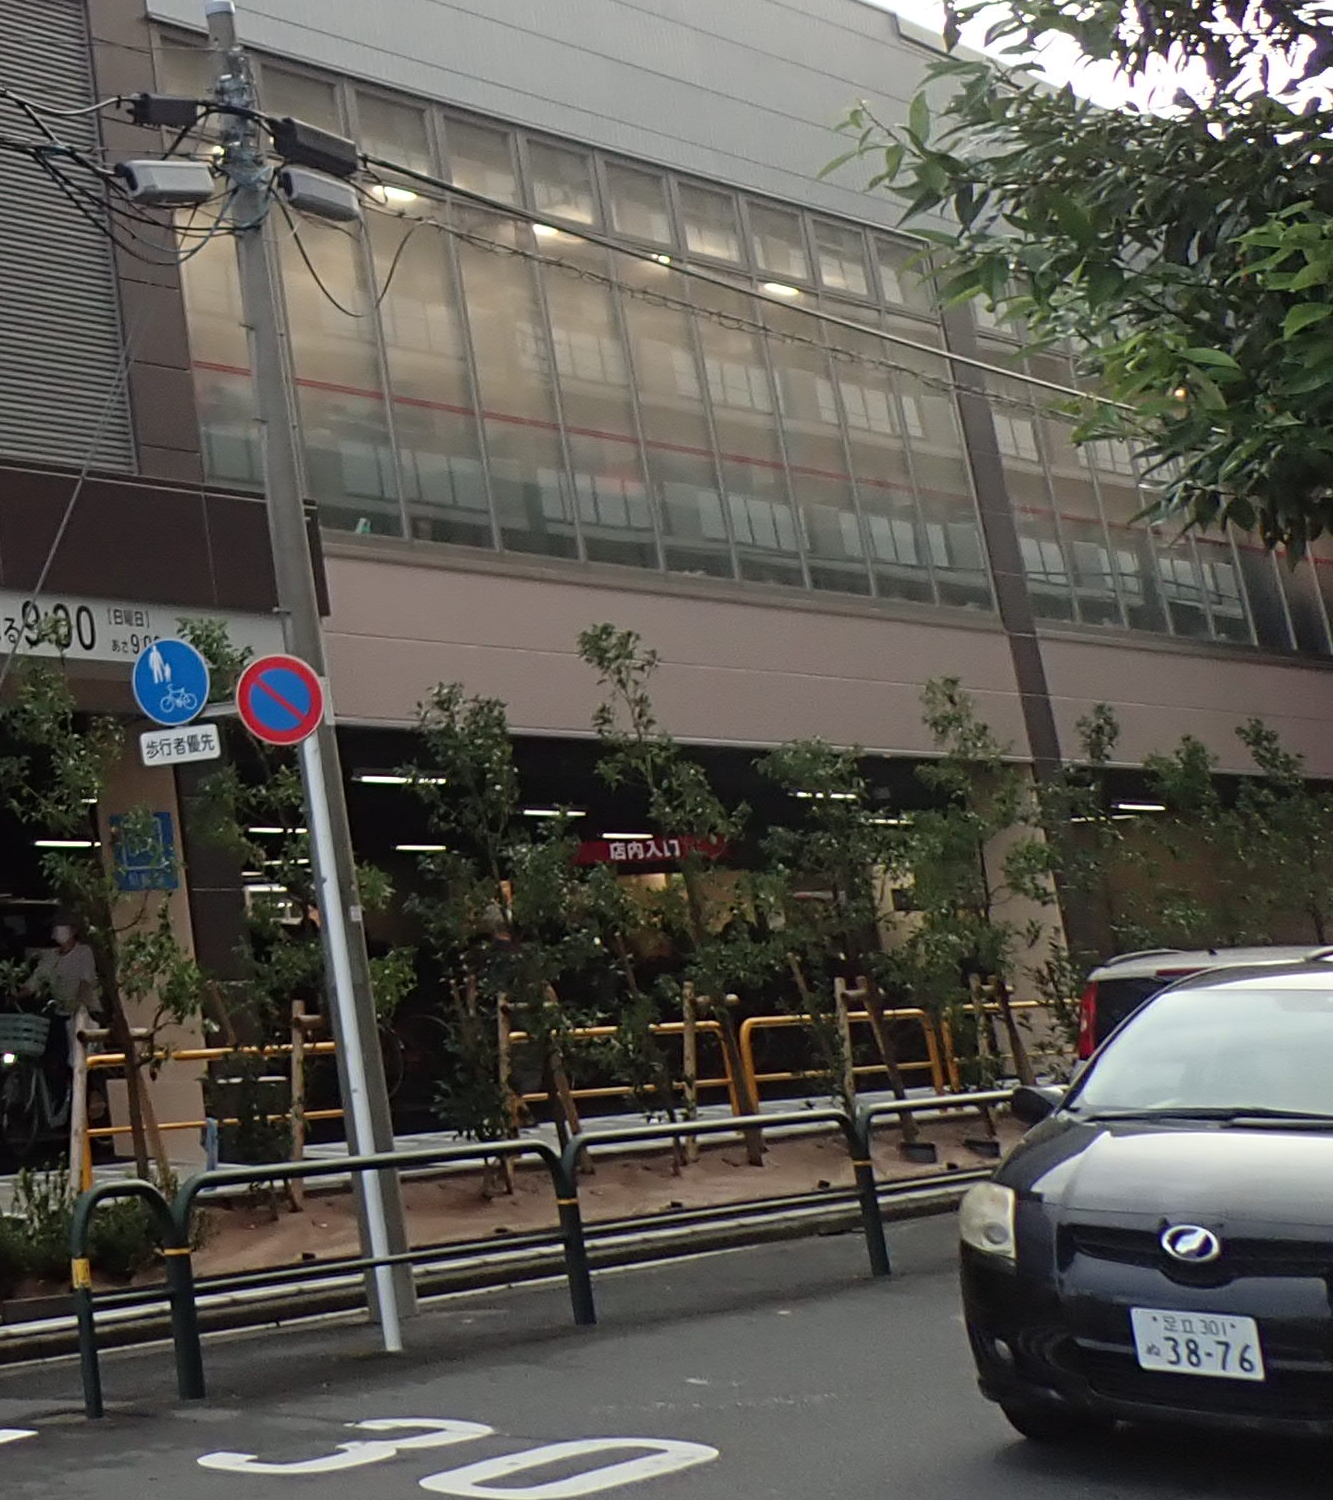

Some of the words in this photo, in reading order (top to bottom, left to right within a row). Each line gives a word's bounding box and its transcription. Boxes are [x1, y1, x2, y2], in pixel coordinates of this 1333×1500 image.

[146, 734, 214, 759] 歩行者優先
[1164, 1337, 1254, 1372] 38-76
[197, 1417, 720, 1500] 30
